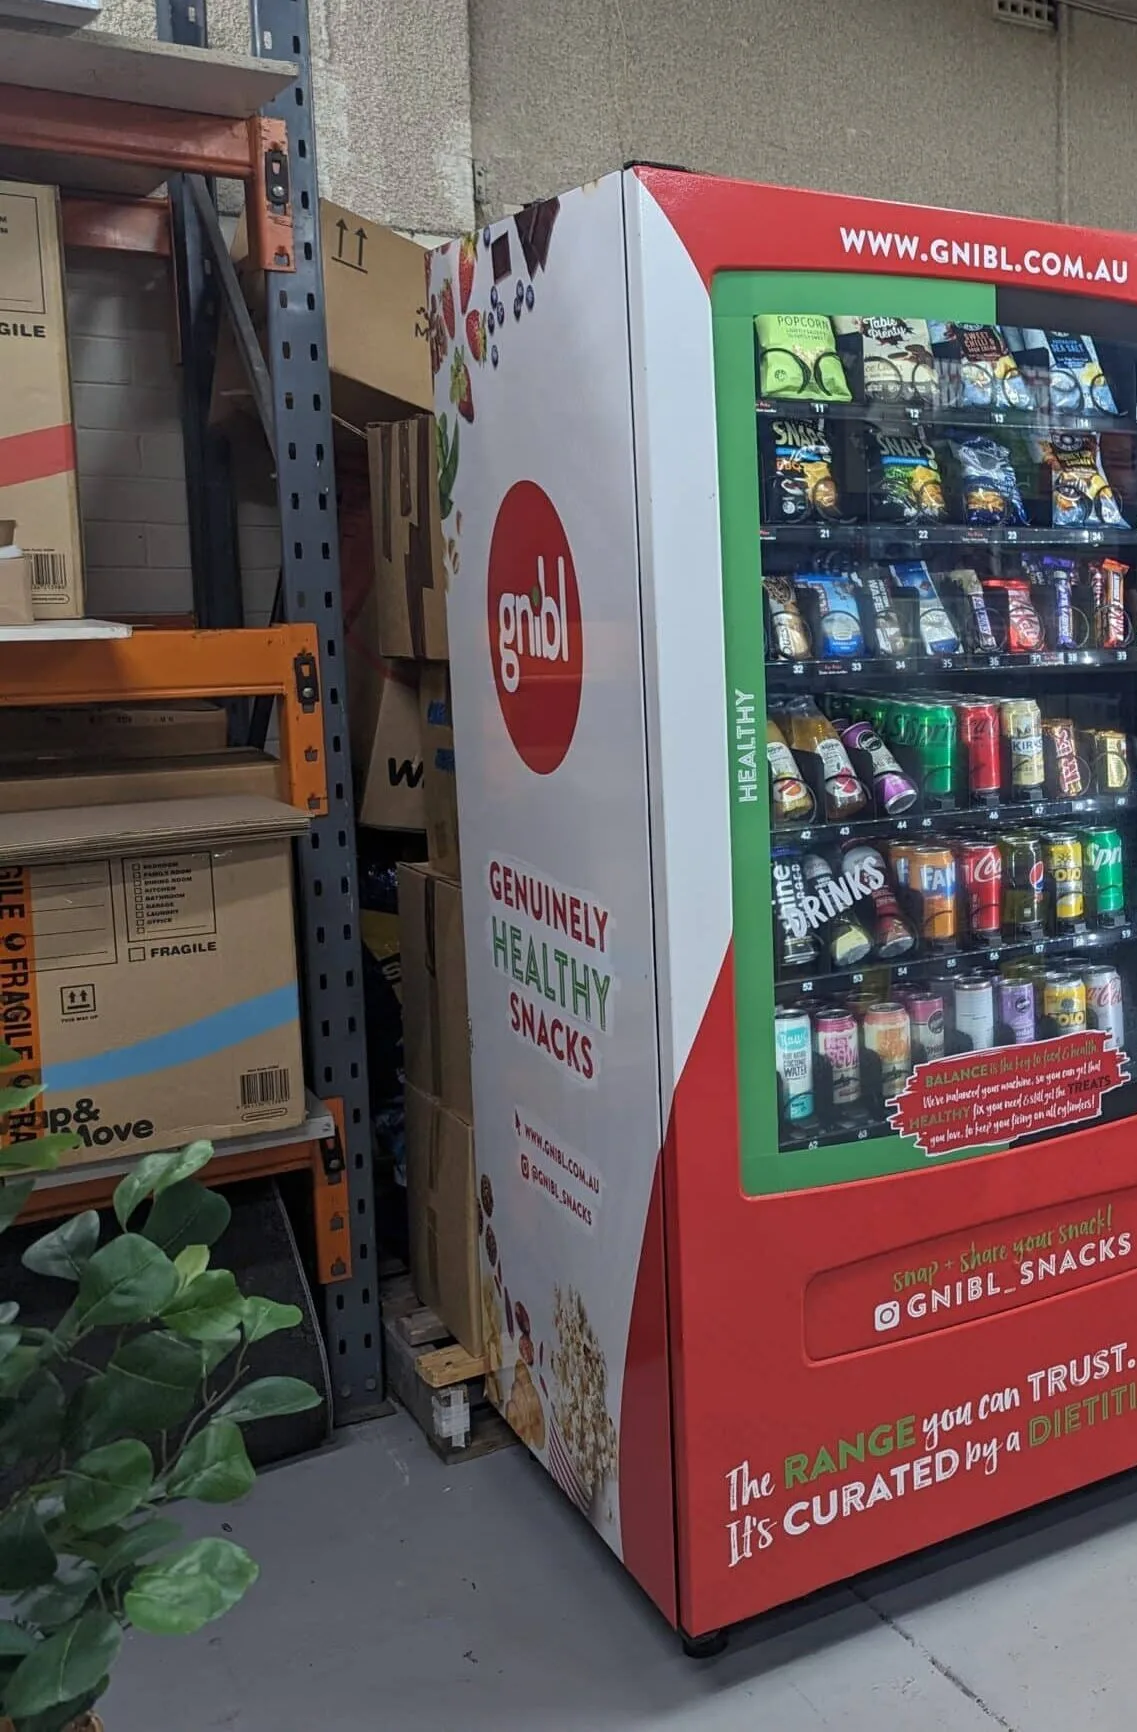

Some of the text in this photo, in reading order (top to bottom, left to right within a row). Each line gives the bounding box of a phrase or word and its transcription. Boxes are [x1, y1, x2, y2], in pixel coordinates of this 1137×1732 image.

[839, 226, 1129, 284] WWW.GNIBL.COM.AU
[777, 315, 829, 330] POPCORN
[863, 316, 897, 329] Table
[814, 403, 825, 413] 11
[910, 409, 920, 419] 12
[820, 530, 830, 538] 21
[918, 530, 928, 539] 22
[499, 555, 569, 693] gnibl
[852, 663, 862, 671] 33
[896, 661, 905, 669] 34
[943, 659, 952, 668] 35
[989, 657, 999, 666] 36
[735, 689, 758, 803] HEALTHY
[897, 821, 907, 829] 44
[922, 819, 932, 827] 45
[801, 831, 811, 839] 42
[840, 827, 850, 836] 43
[789, 856, 885, 937] DRINKS
[490, 861, 608, 953] GENUINELY
[151, 941, 217, 958] FRAGILE
[947, 959, 956, 967] 55
[492, 915, 611, 1032] HEALTHY
[853, 974, 863, 982] 53
[898, 967, 907, 975] 54
[802, 982, 812, 991] 52
[0, 958, 33, 1061] FRAGILE
[510, 992, 594, 1079] SNACKS
[925, 1064, 988, 1088] BALANCE
[981, 1084, 1000, 1099] your
[1036, 1075, 1045, 1085] so
[1046, 1071, 1061, 1085] you
[1062, 1068, 1075, 1078] can
[1076, 1062, 1086, 1080] get
[1088, 1060, 1101, 1075] that
[910, 1105, 971, 1129] HEALTHY
[973, 1103, 985, 1121] fix
[986, 1103, 1003, 1117] you
[1004, 1093, 1022, 1109] need
[1030, 1088, 1044, 1104] still
[1044, 1087, 1055, 1105] get
[1056, 1085, 1066, 1099] the
[1068, 1075, 1112, 1094] TREATS
[930, 1134, 946, 1147] you
[965, 1123, 974, 1138] to
[975, 1121, 991, 1136] keep
[993, 1118, 1010, 1134] you
[1011, 1112, 1032, 1130] firing
[1034, 1110, 1044, 1120] on
[1045, 1102, 1057, 1117] all
[1057, 1094, 1095, 1117] cylinders!
[858, 1130, 867, 1138] 63
[808, 1140, 818, 1149] 62
[525, 1124, 599, 1194] WWW.GNIBL.COM.AU
[532, 1165, 592, 1226] @GNIBL_SNACKS
[893, 1259, 940, 1293] snap
[960, 1241, 1009, 1275] share
[1012, 1230, 1053, 1266] your
[1058, 1203, 1113, 1243] snack!
[907, 1231, 1132, 1319] GNIBL_SNACKS
[725, 1342, 1137, 1512] The RANGE you can TRUST.
[725, 1514, 777, 1568] It's
[782, 1448, 960, 1536] CURATED
[965, 1440, 1004, 1476] by
[1006, 1429, 1022, 1453] a
